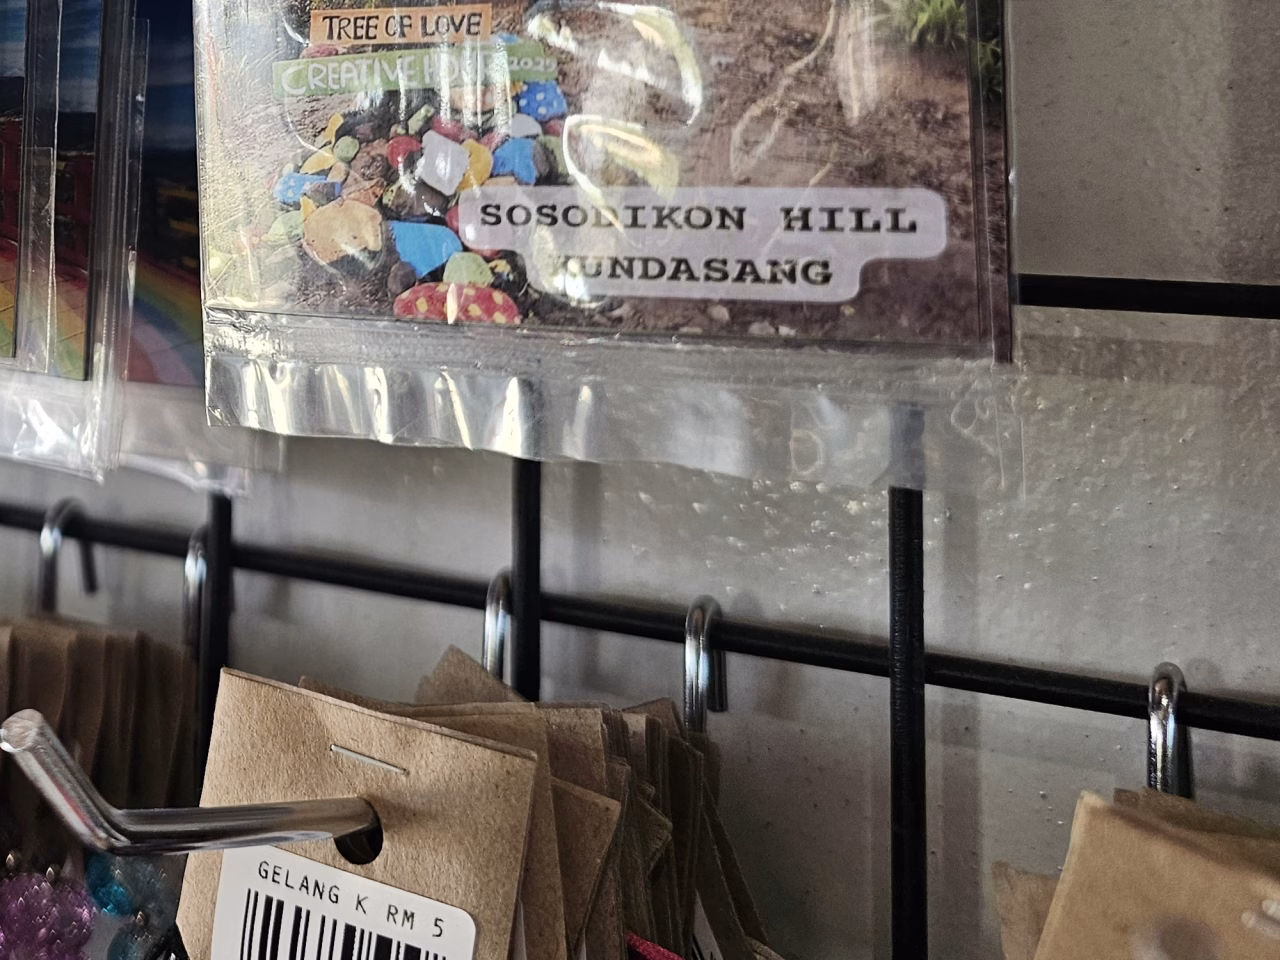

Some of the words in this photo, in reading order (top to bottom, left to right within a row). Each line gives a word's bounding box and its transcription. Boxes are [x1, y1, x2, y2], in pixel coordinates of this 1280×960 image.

[322, 15, 380, 41] TREE
[384, 14, 413, 37] OF
[420, 11, 483, 36] LOVE
[280, 53, 418, 96] CREATIVE
[479, 202, 747, 232] SOSODIKON
[781, 206, 919, 235] HILL
[257, 860, 341, 905] GELANG
[355, 894, 369, 915] K
[386, 903, 417, 931] RM
[432, 917, 445, 938] 5
